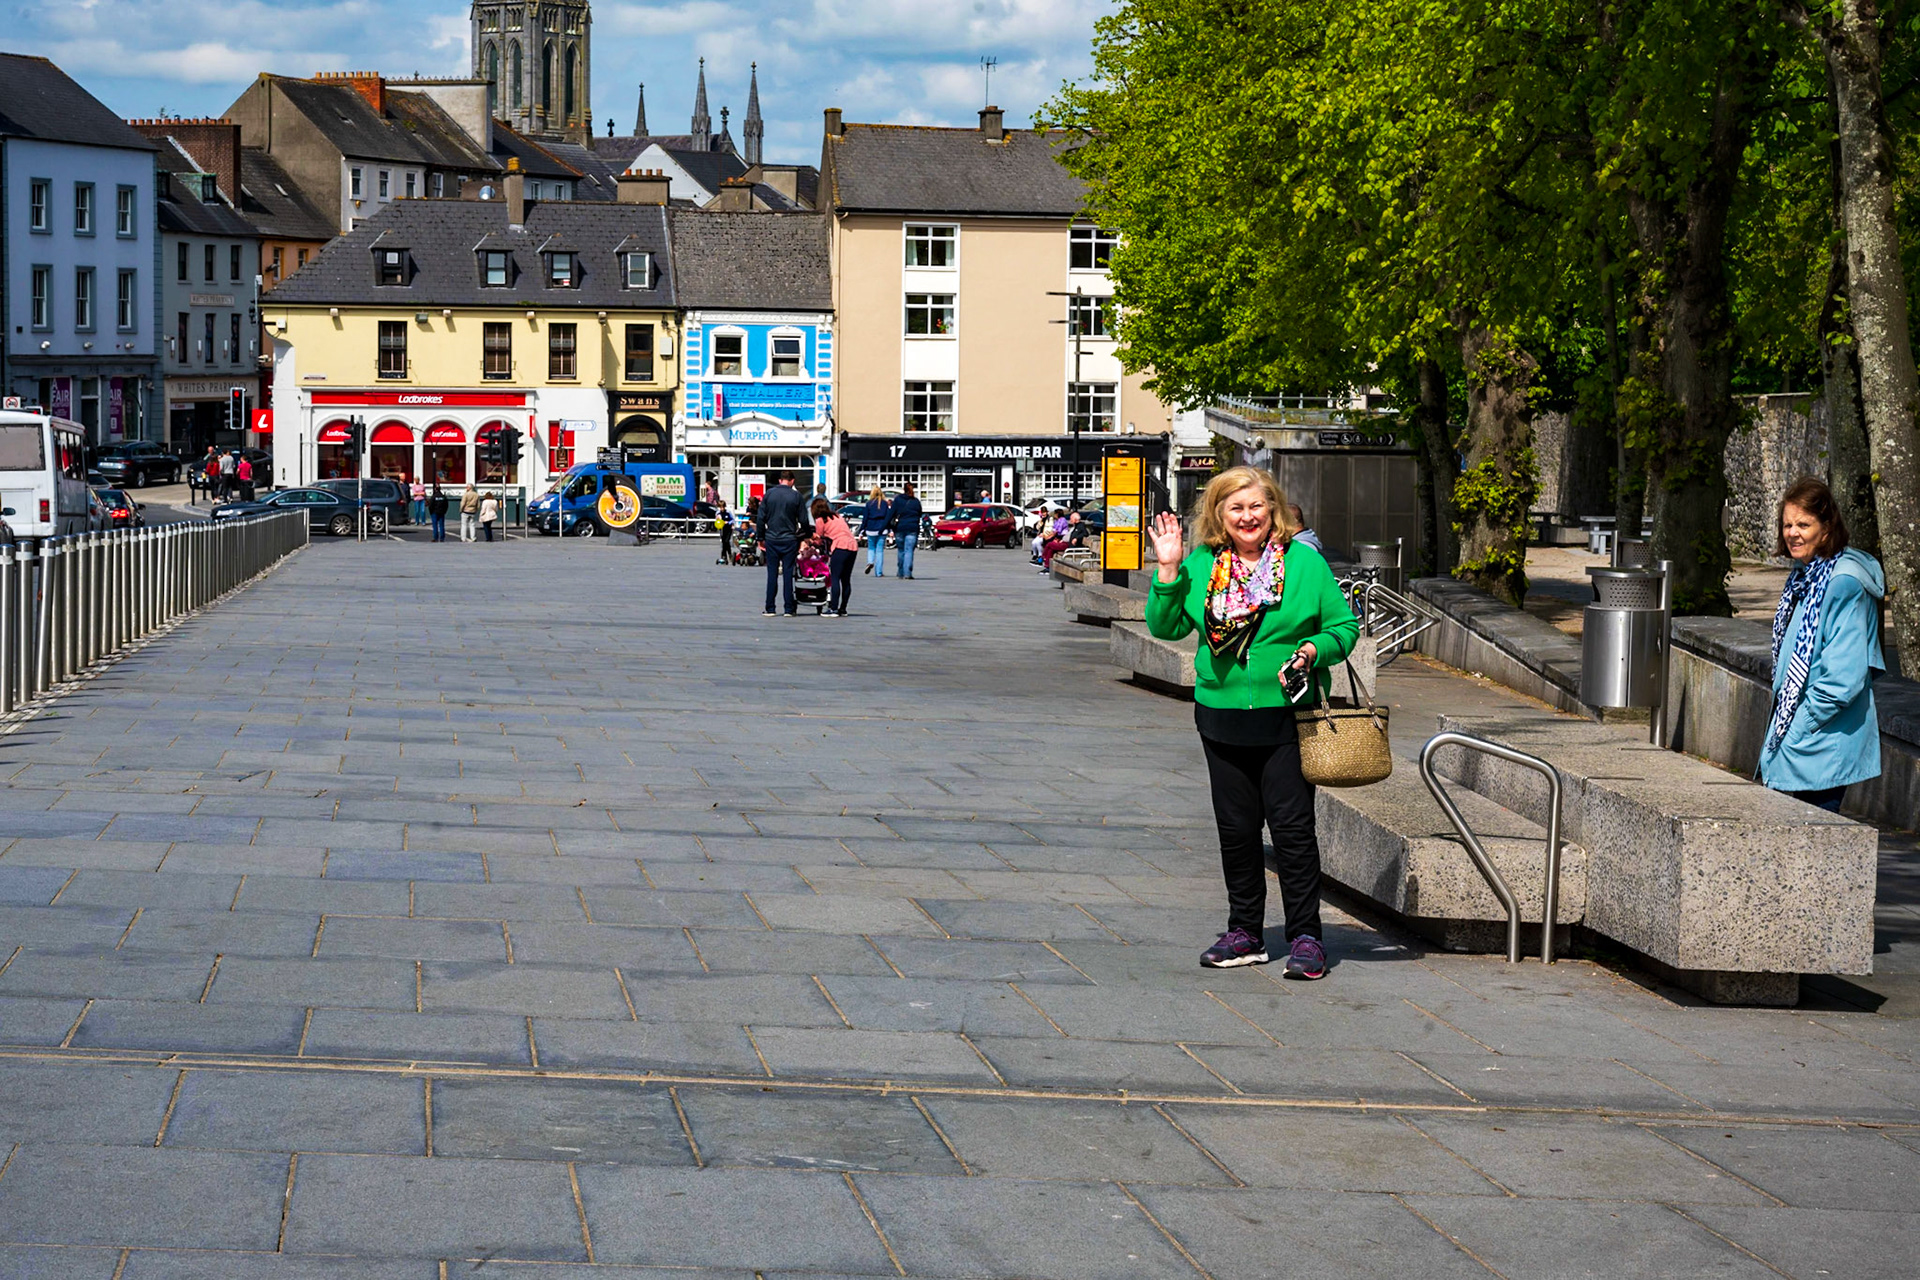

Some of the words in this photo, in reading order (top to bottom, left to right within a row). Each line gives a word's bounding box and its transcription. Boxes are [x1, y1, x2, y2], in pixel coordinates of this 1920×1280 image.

[178, 382, 206, 393] WHITES
[52, 390, 70, 402] FAIR
[398, 394, 444, 404] Ladbrokes
[620, 396, 660, 405] Swans
[257, 413, 269, 429] L
[432, 430, 458, 438] Ladbrokes
[729, 430, 778, 441] MURPHY'S
[889, 445, 907, 457] 17
[946, 445, 973, 458] THE
[974, 445, 1031, 459] PARADE
[1032, 446, 1061, 459] BAR
